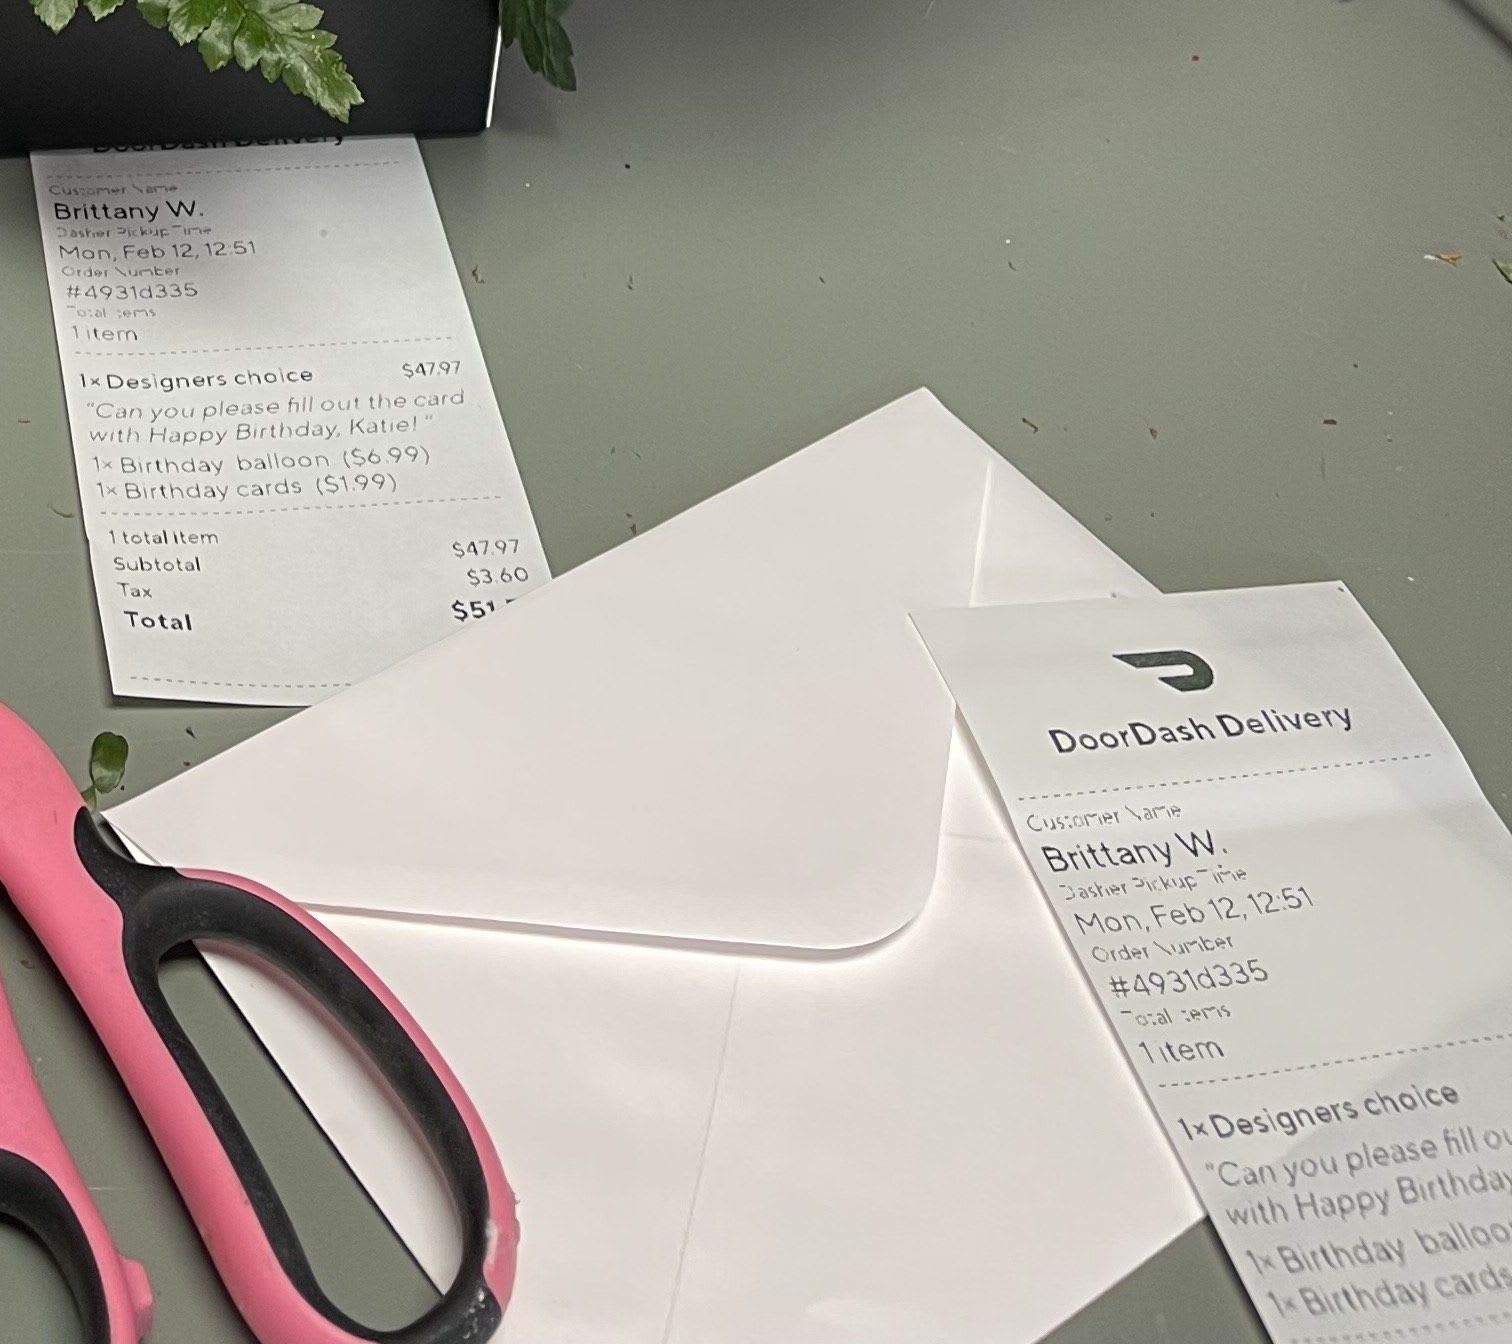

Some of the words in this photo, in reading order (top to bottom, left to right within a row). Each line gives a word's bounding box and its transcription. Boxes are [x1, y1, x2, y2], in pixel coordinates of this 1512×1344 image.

[54, 201, 159, 223] Brittany
[165, 200, 205, 218] W.
[59, 245, 118, 263] Mon,
[123, 244, 166, 259] Feb
[171, 242, 200, 260] 12,
[205, 240, 257, 257] 12:51
[66, 282, 199, 301] #4931d335
[87, 325, 139, 342] item
[80, 372, 101, 389] 1x
[106, 372, 228, 393] Designers
[234, 367, 314, 387] choice
[401, 360, 462, 379] $47.97
[150, 406, 196, 424] you
[202, 399, 281, 422] please
[320, 396, 361, 413] out
[369, 393, 407, 410] the
[413, 387, 465, 407] card
[89, 426, 140, 443] with
[148, 426, 228, 446] Happy
[236, 420, 341, 441] Birthday,
[349, 415, 417, 435] Katie!
[92, 455, 114, 472] 1x
[119, 456, 224, 476] Birthday
[236, 451, 330, 472] balloon
[343, 445, 430, 469] ($6.99)
[96, 481, 118, 498] 1x
[124, 482, 229, 502] Birthday
[236, 478, 303, 497] cards
[316, 473, 397, 495] ($1.99)
[108, 529, 116, 544] 1
[122, 529, 168, 545] total
[172, 530, 219, 545] item
[452, 538, 519, 559] $47.97
[113, 555, 201, 572] Subtotal
[466, 566, 530, 588] $3.60
[116, 581, 153, 599] Tax
[123, 610, 193, 632] Total
[1048, 717, 1216, 754] DoorDash
[1215, 707, 1353, 738] Delivery
[1040, 841, 1172, 873] Brittany
[1174, 829, 1229, 858] W.
[1074, 911, 1151, 935] Mon,
[1150, 902, 1205, 928] Feb
[1208, 896, 1248, 921] 12,
[1247, 886, 1315, 914] 12:51
[1109, 958, 1269, 998] #4931d335
[1138, 1041, 1155, 1064] 1
[1159, 1040, 1225, 1063] item
[1177, 1117, 1209, 1141] 1x
[1208, 1100, 1359, 1138] Designers
[1363, 1083, 1460, 1116] choice
[1282, 1155, 1339, 1188] you
[1345, 1138, 1438, 1178] please
[1225, 1196, 1289, 1226] with
[1293, 1187, 1390, 1224] Happy
[1276, 1235, 1407, 1274] Birthday
[1297, 1278, 1430, 1317] Birthday
